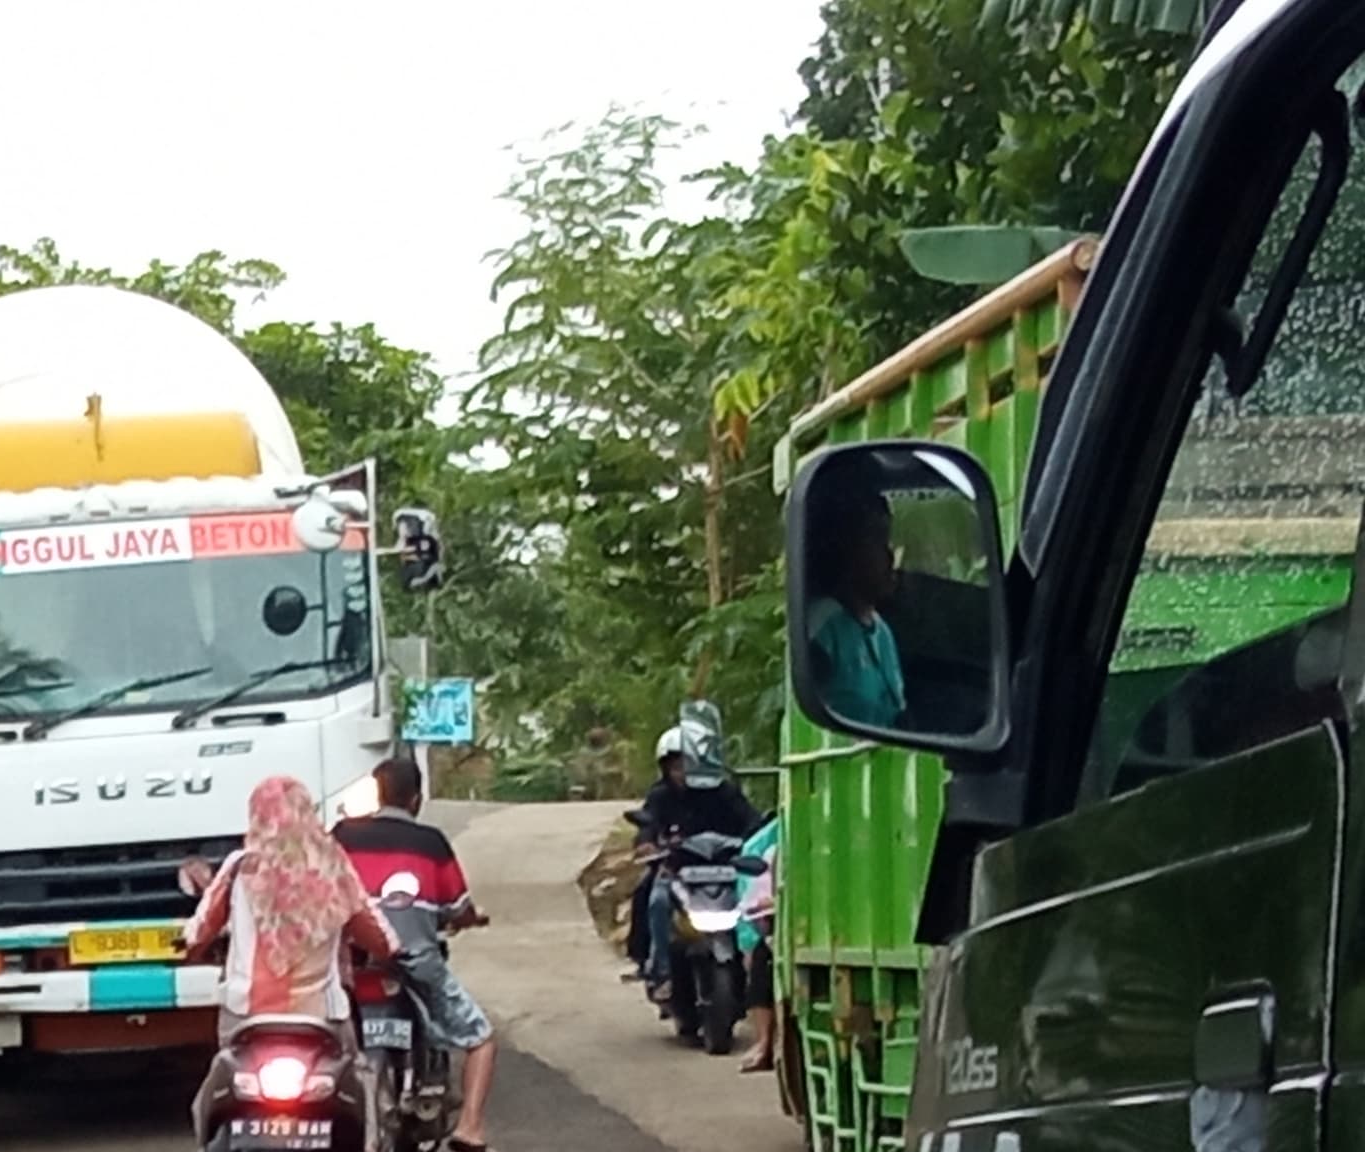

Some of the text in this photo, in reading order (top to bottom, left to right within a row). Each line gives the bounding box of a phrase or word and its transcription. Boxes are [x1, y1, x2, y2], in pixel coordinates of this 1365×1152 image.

[105, 528, 180, 558] JAYA
[190, 518, 290, 552] BETON
[33, 767, 213, 805] ISUZU
